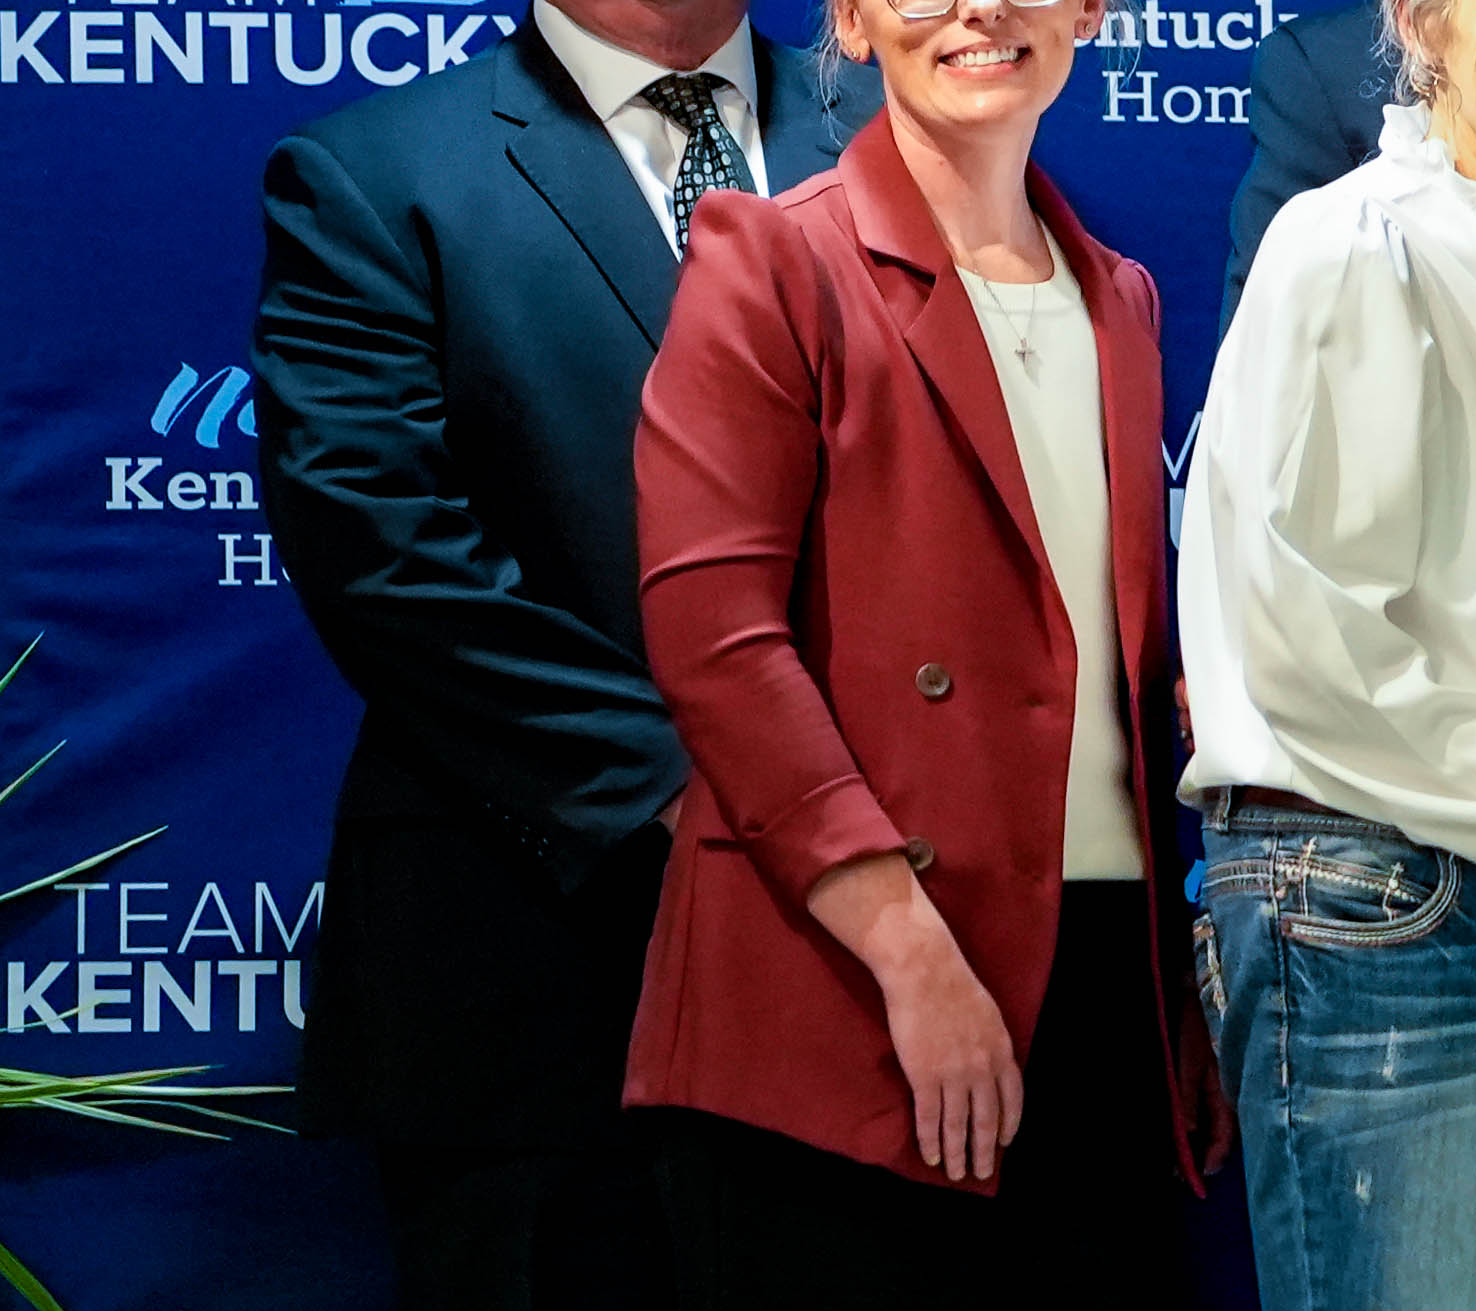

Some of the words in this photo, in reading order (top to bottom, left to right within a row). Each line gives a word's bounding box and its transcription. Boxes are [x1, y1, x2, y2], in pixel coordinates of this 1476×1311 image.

[0, 10, 516, 86] KENTUCK
[1102, 71, 1251, 124] Hom
[54, 882, 325, 954] TEAM
